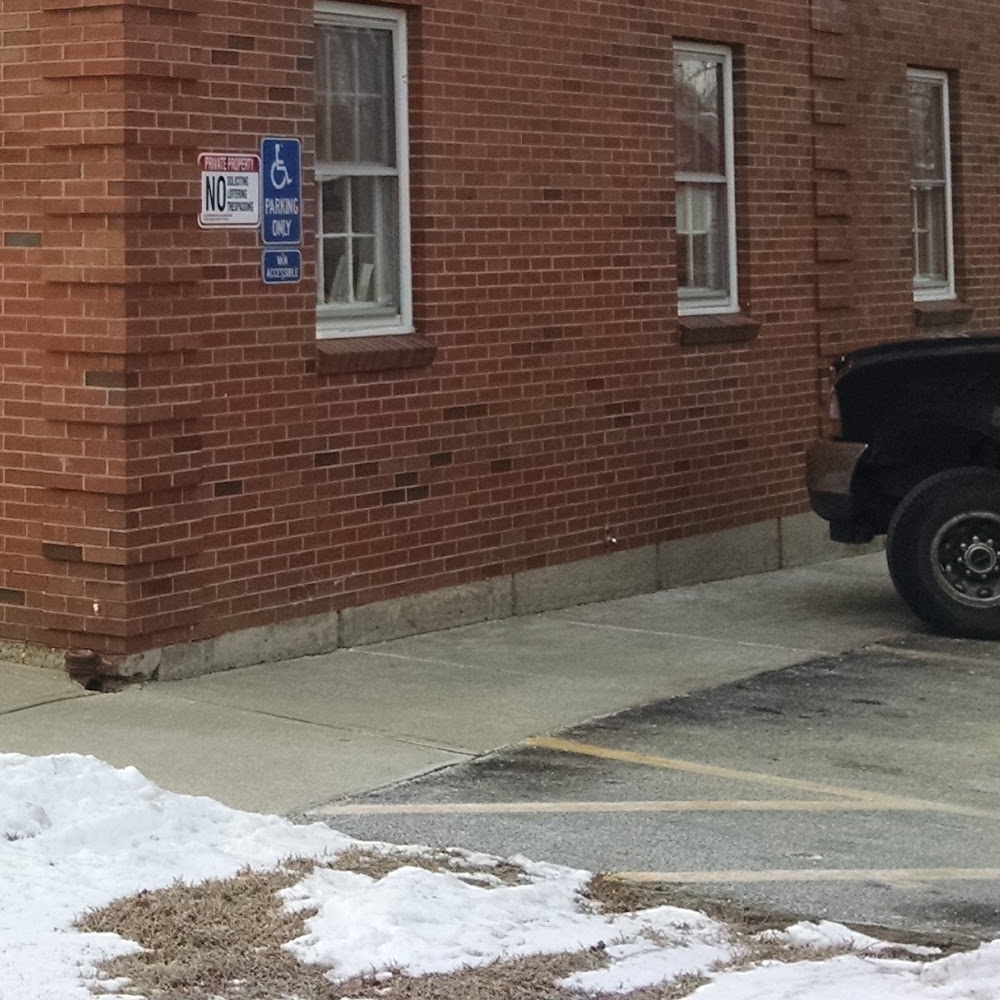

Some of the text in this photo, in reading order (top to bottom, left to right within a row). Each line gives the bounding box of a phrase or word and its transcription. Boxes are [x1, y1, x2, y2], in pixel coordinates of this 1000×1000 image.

[204, 157, 254, 171] PRIVATE PROPERTY
[205, 175, 227, 212] NO
[265, 198, 298, 215] PARKING
[272, 219, 292, 237] ONLY
[266, 267, 299, 278] ACCESSIBLE
